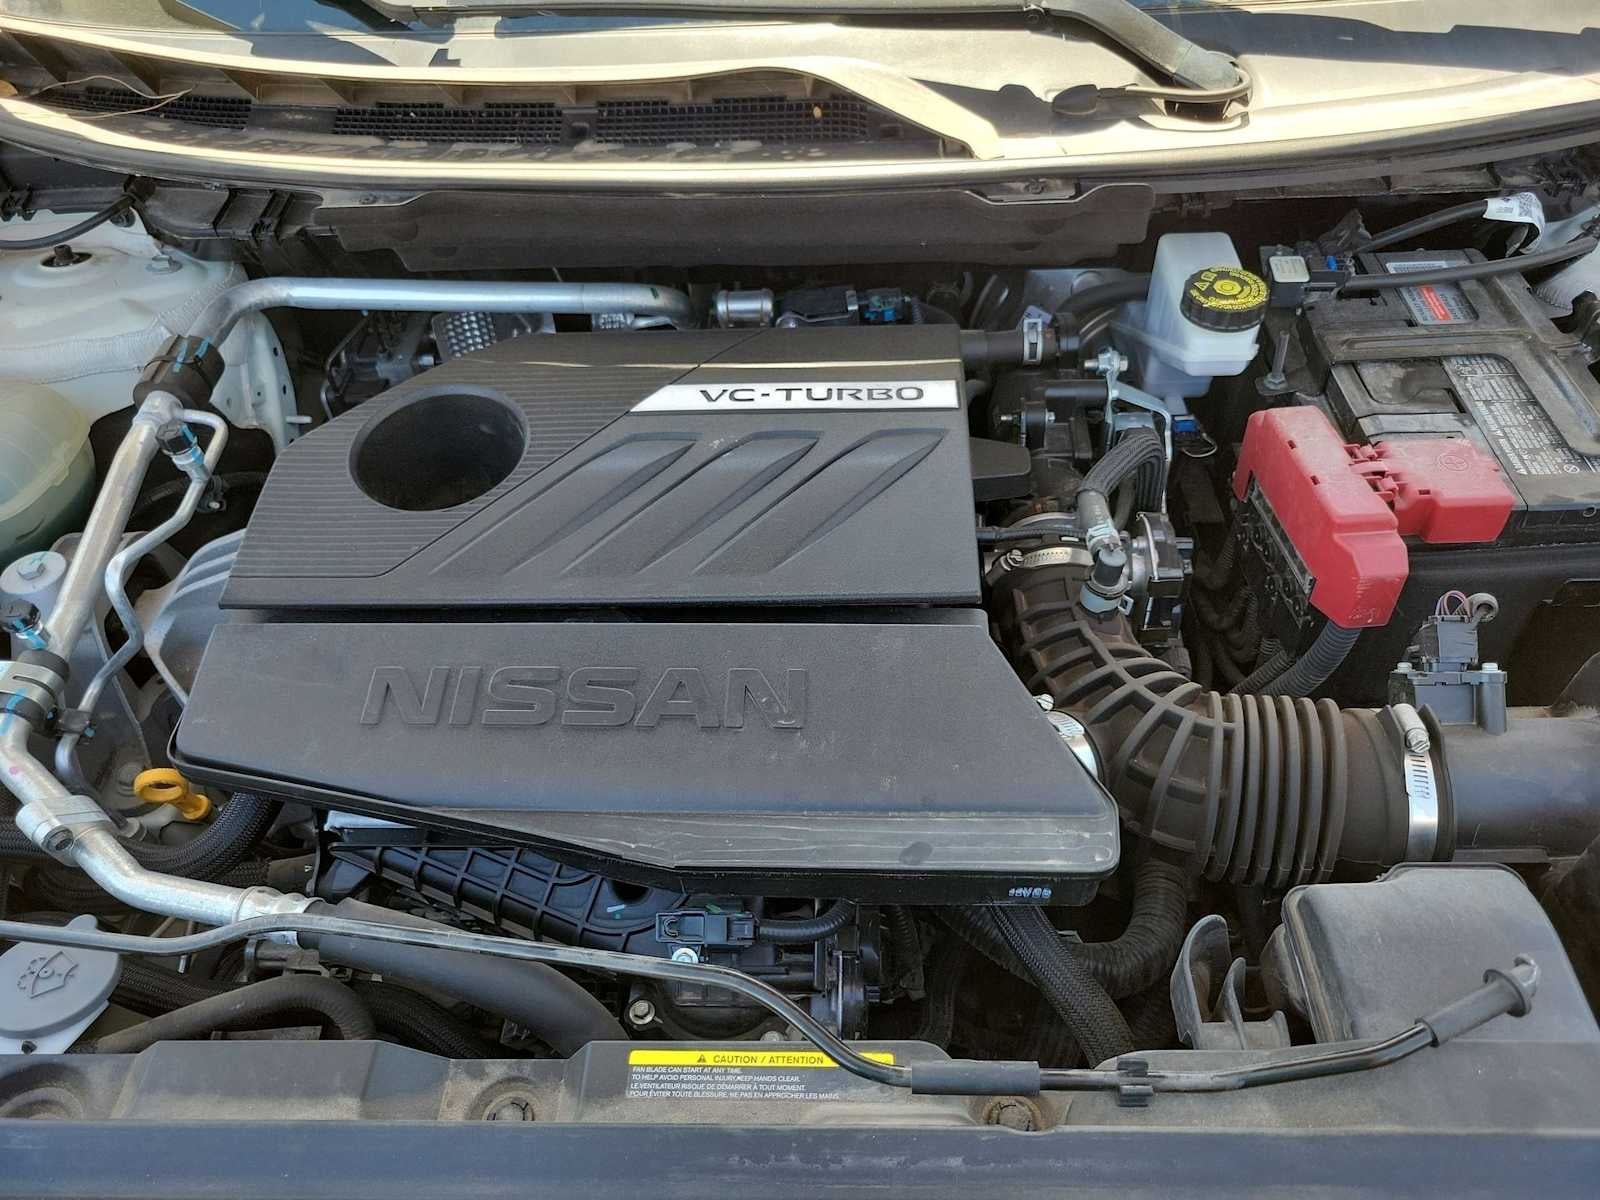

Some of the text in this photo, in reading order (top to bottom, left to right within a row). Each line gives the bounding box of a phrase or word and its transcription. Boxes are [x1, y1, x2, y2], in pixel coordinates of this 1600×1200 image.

[699, 387, 924, 402] VC-TURBO
[359, 665, 809, 730] NISSAN
[713, 1054, 757, 1064] CAUTION
[768, 1055, 824, 1065] ATTENTION
[716, 1082, 752, 1091] DÉMARRER
[629, 1090, 648, 1098] POUR
[671, 1090, 692, 1098] TOUTE
